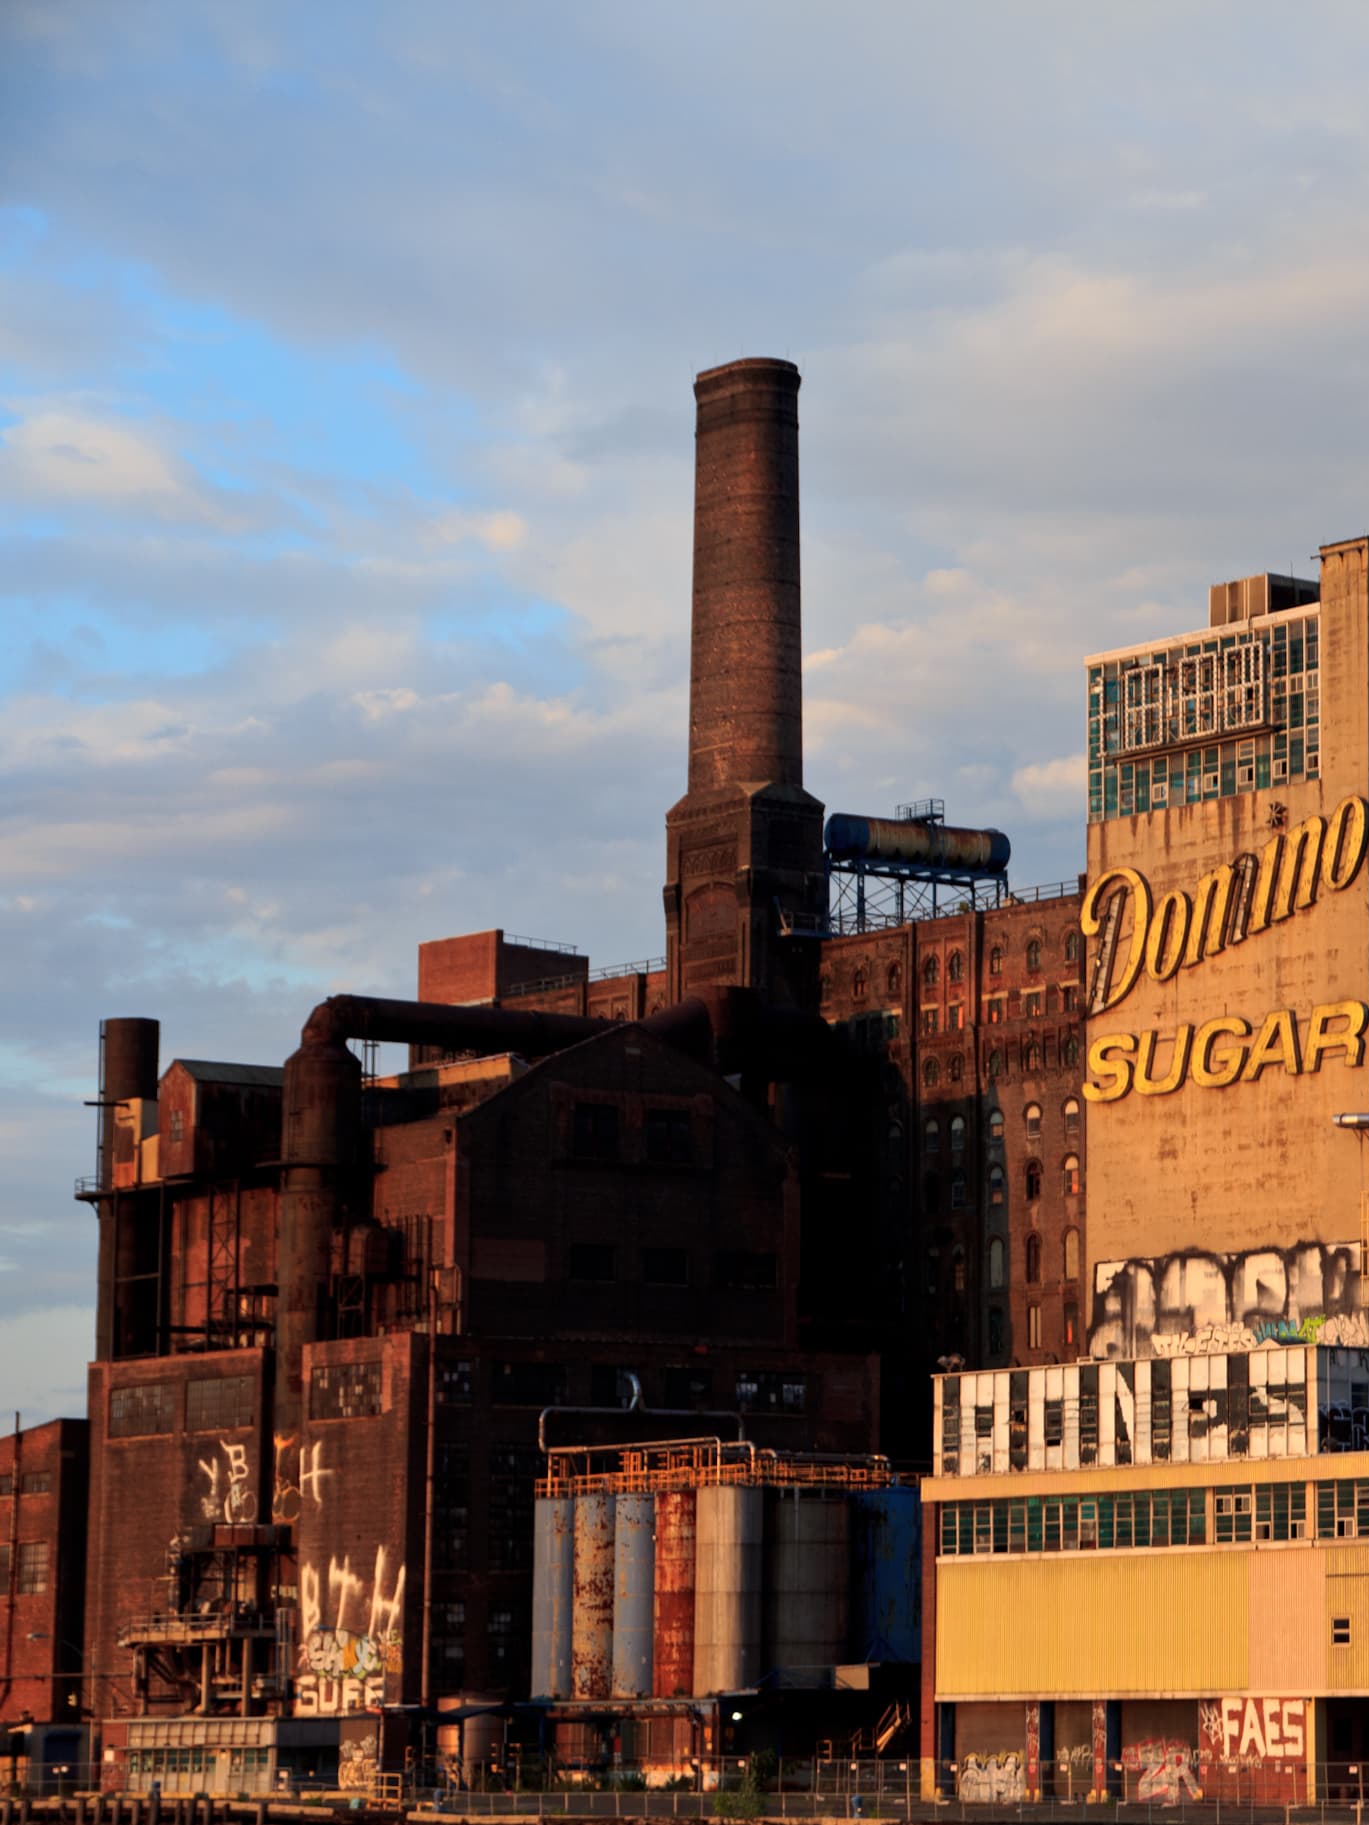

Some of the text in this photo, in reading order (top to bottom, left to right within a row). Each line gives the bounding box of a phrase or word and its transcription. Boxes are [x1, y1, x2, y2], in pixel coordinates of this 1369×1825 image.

[1081, 796, 1369, 1018] Domino
[1082, 999, 1369, 1102] SUGAR
[1221, 1697, 1303, 1758] FAES
